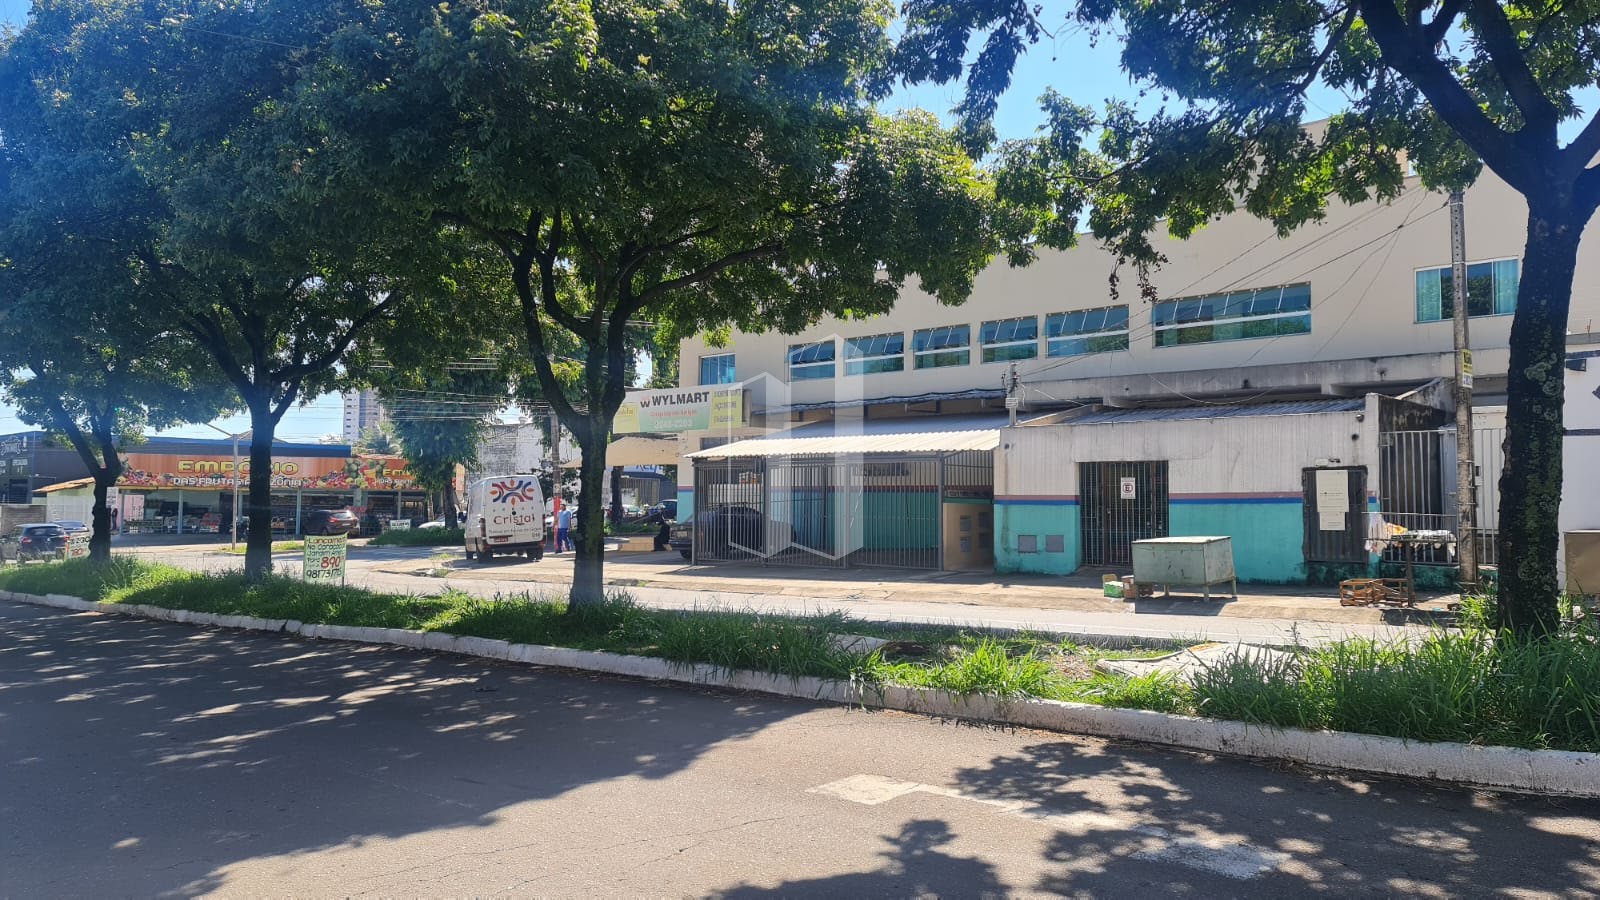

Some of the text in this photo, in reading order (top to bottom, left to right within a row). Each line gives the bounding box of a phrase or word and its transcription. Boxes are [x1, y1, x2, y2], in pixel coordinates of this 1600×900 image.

[652, 391, 710, 406] WYLMART
[177, 457, 298, 475] EMPÓIO
[173, 477, 196, 486] DAS
[493, 513, 535, 525] Cristal
